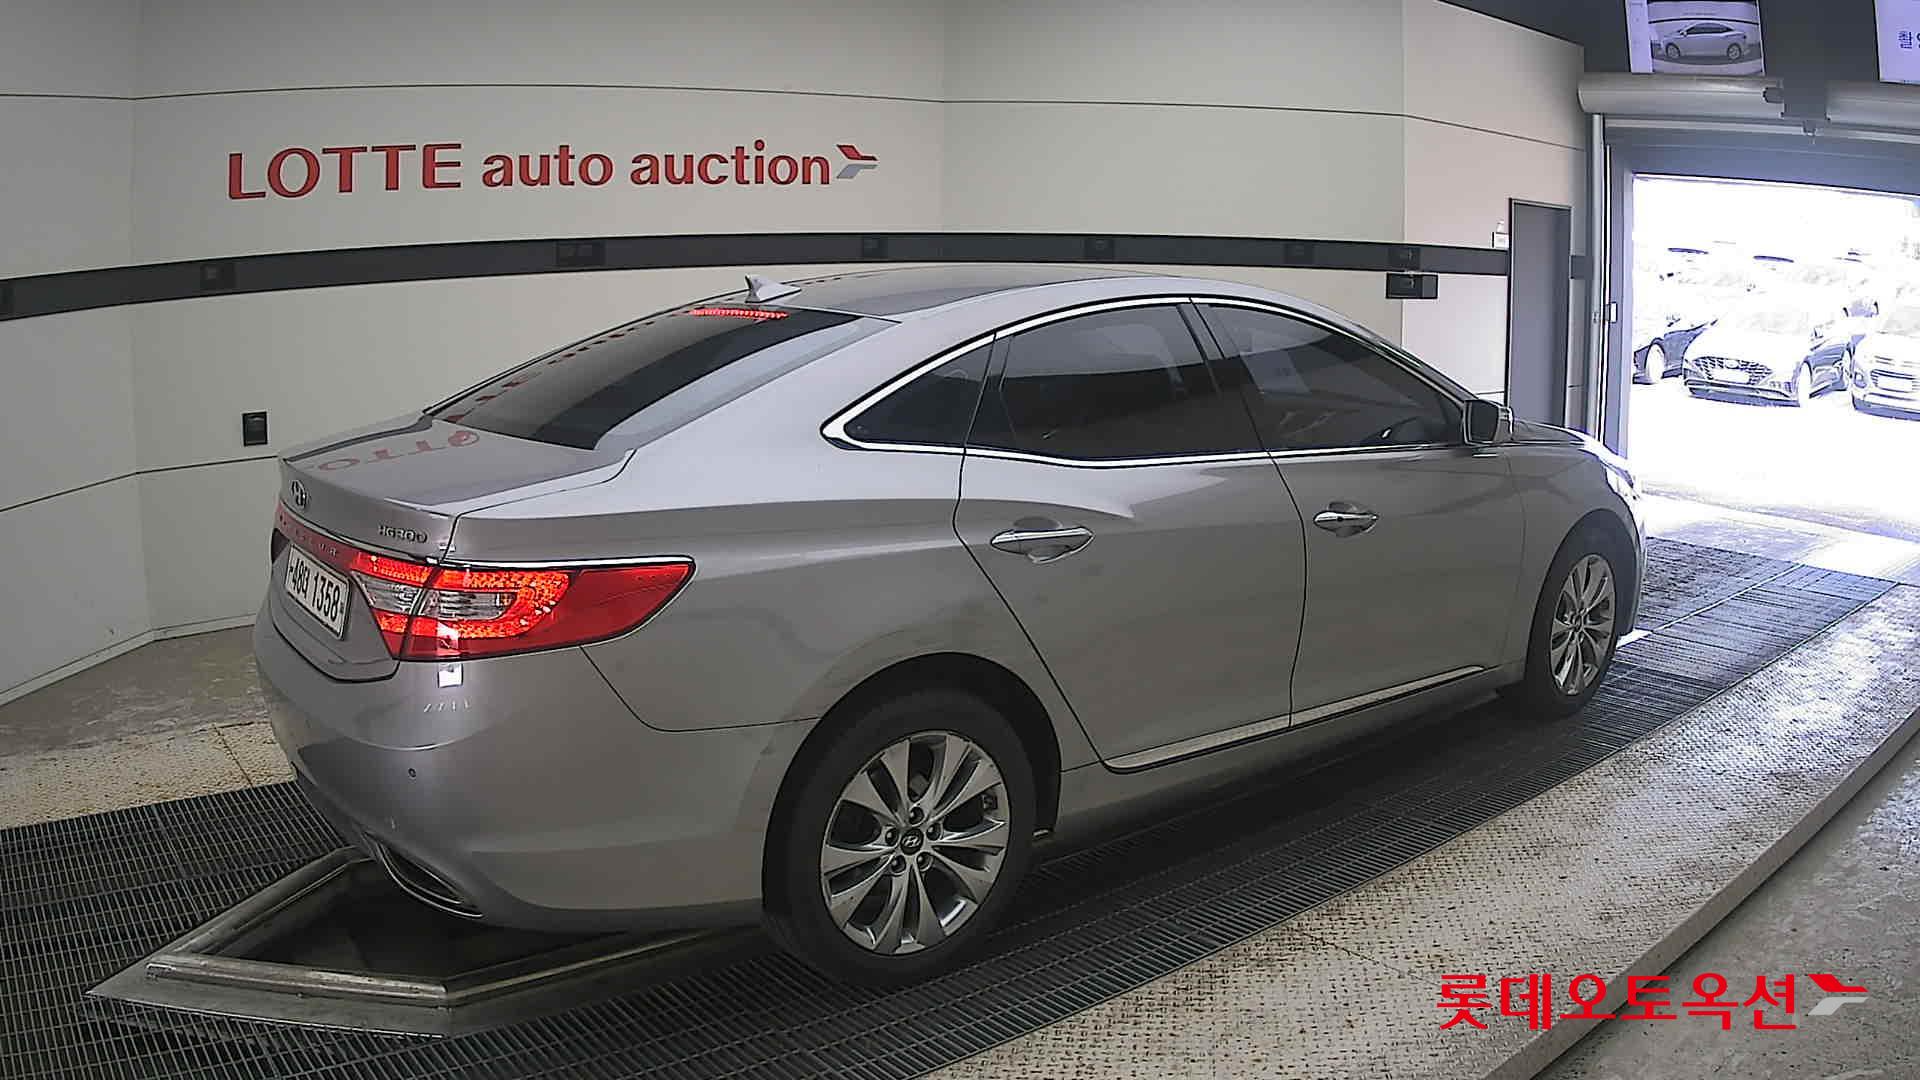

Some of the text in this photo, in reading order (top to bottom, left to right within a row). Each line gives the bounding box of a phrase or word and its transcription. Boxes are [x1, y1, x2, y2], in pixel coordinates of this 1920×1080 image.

[227, 139, 832, 200] LOTTE auto auction
[311, 571, 341, 622] 1358
